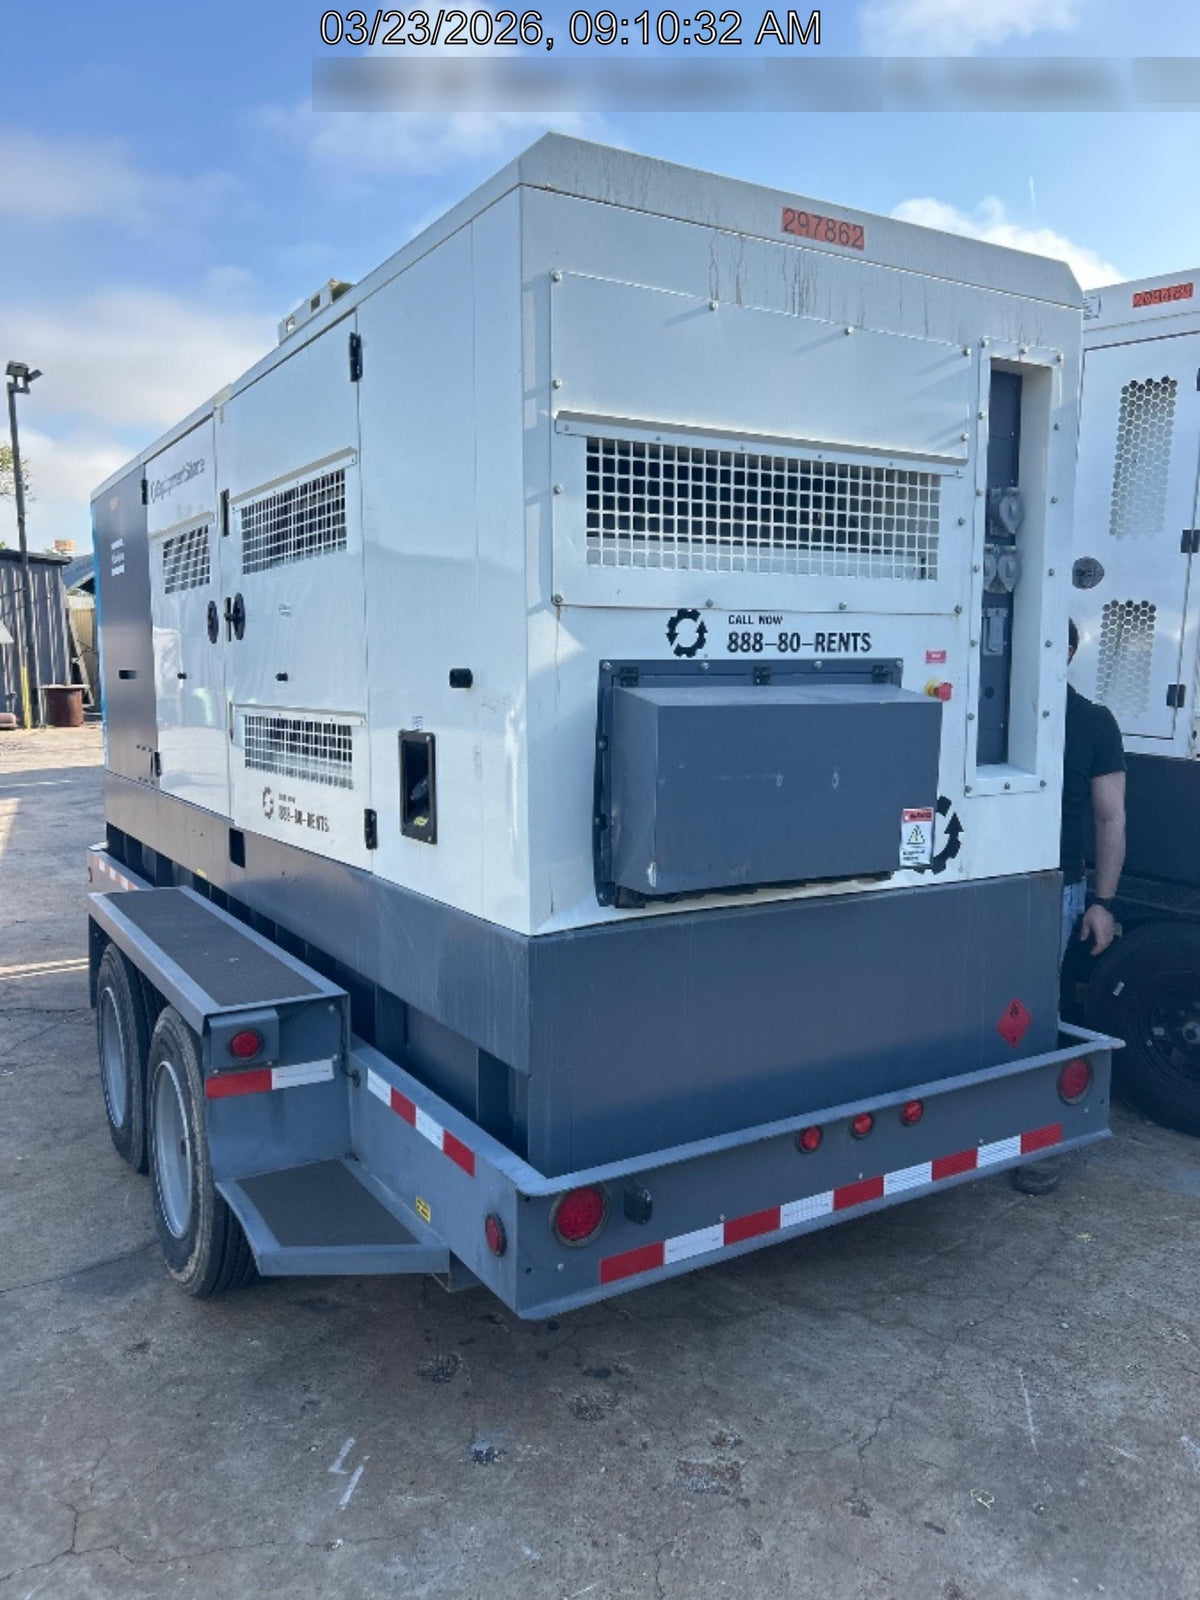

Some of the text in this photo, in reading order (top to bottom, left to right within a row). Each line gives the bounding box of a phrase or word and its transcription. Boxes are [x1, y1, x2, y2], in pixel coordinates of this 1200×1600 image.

[783, 207, 865, 250] 297862
[727, 614, 783, 625] CALL NOW
[726, 631, 873, 653] 888-80-RENTS
